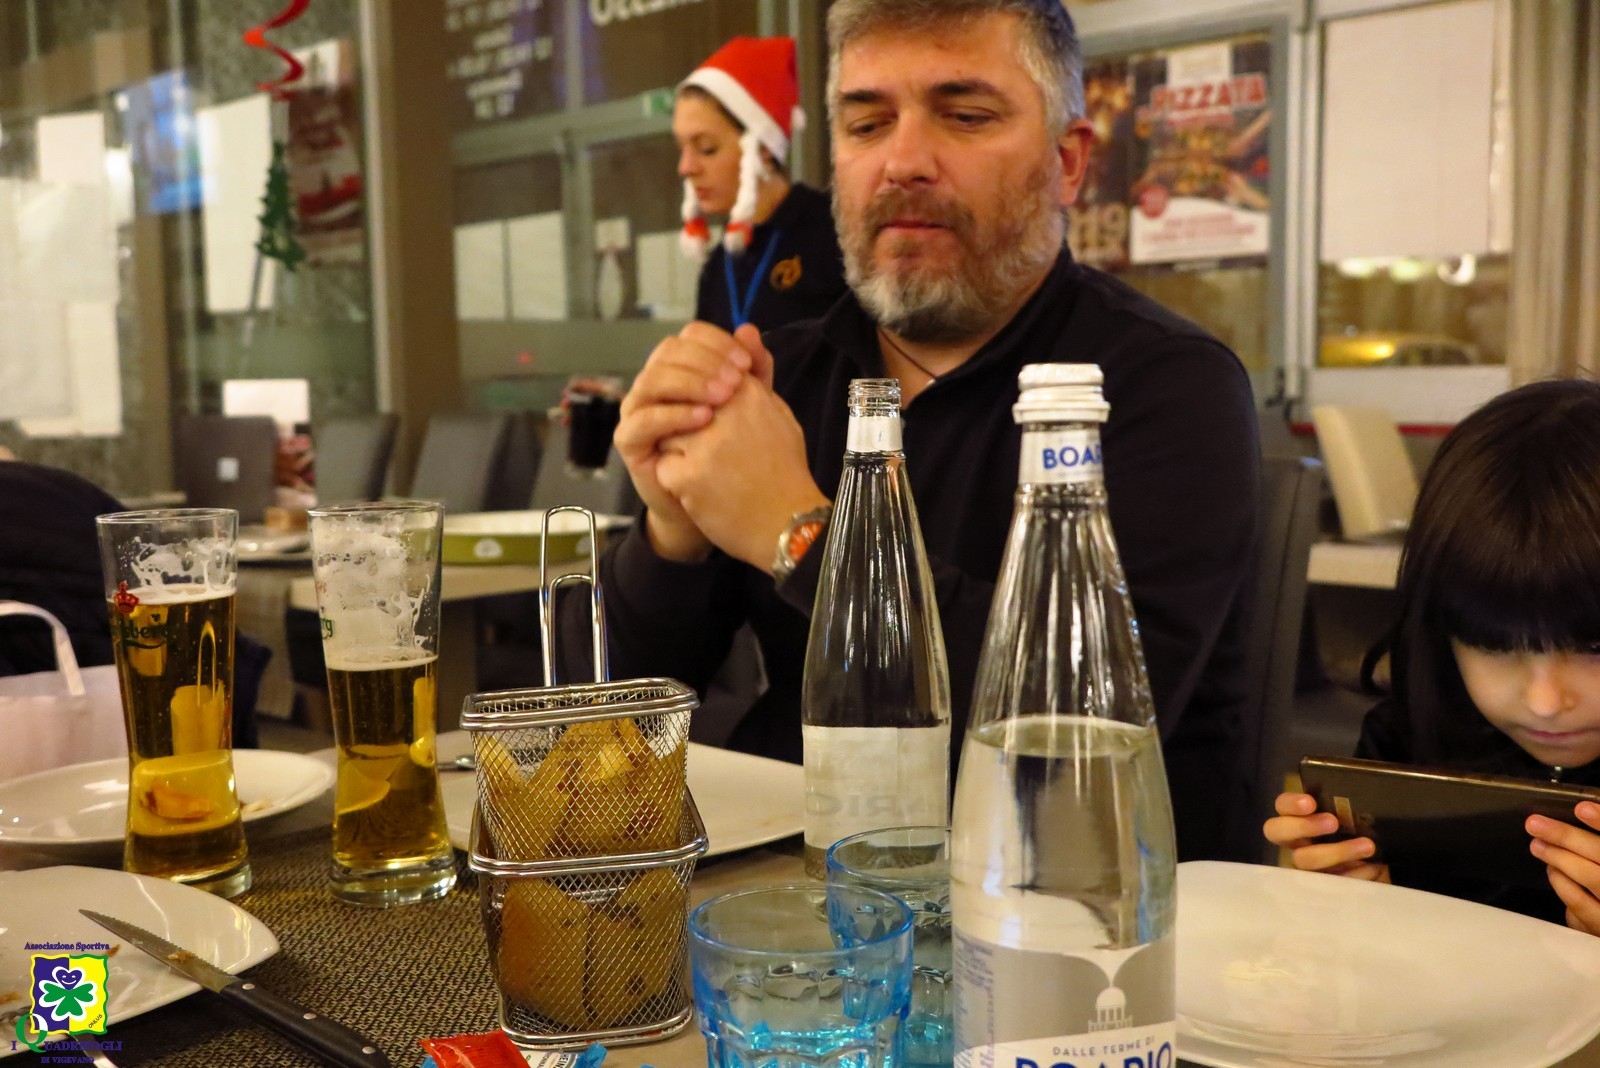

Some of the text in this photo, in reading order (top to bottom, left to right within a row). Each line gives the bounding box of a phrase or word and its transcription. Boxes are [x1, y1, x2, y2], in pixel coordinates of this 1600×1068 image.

[1152, 75, 1265, 112] PIZZATA
[1052, 1046, 1096, 1057] DALLE
[1103, 1039, 1141, 1055] TERME
[1145, 1035, 1155, 1046] DI
